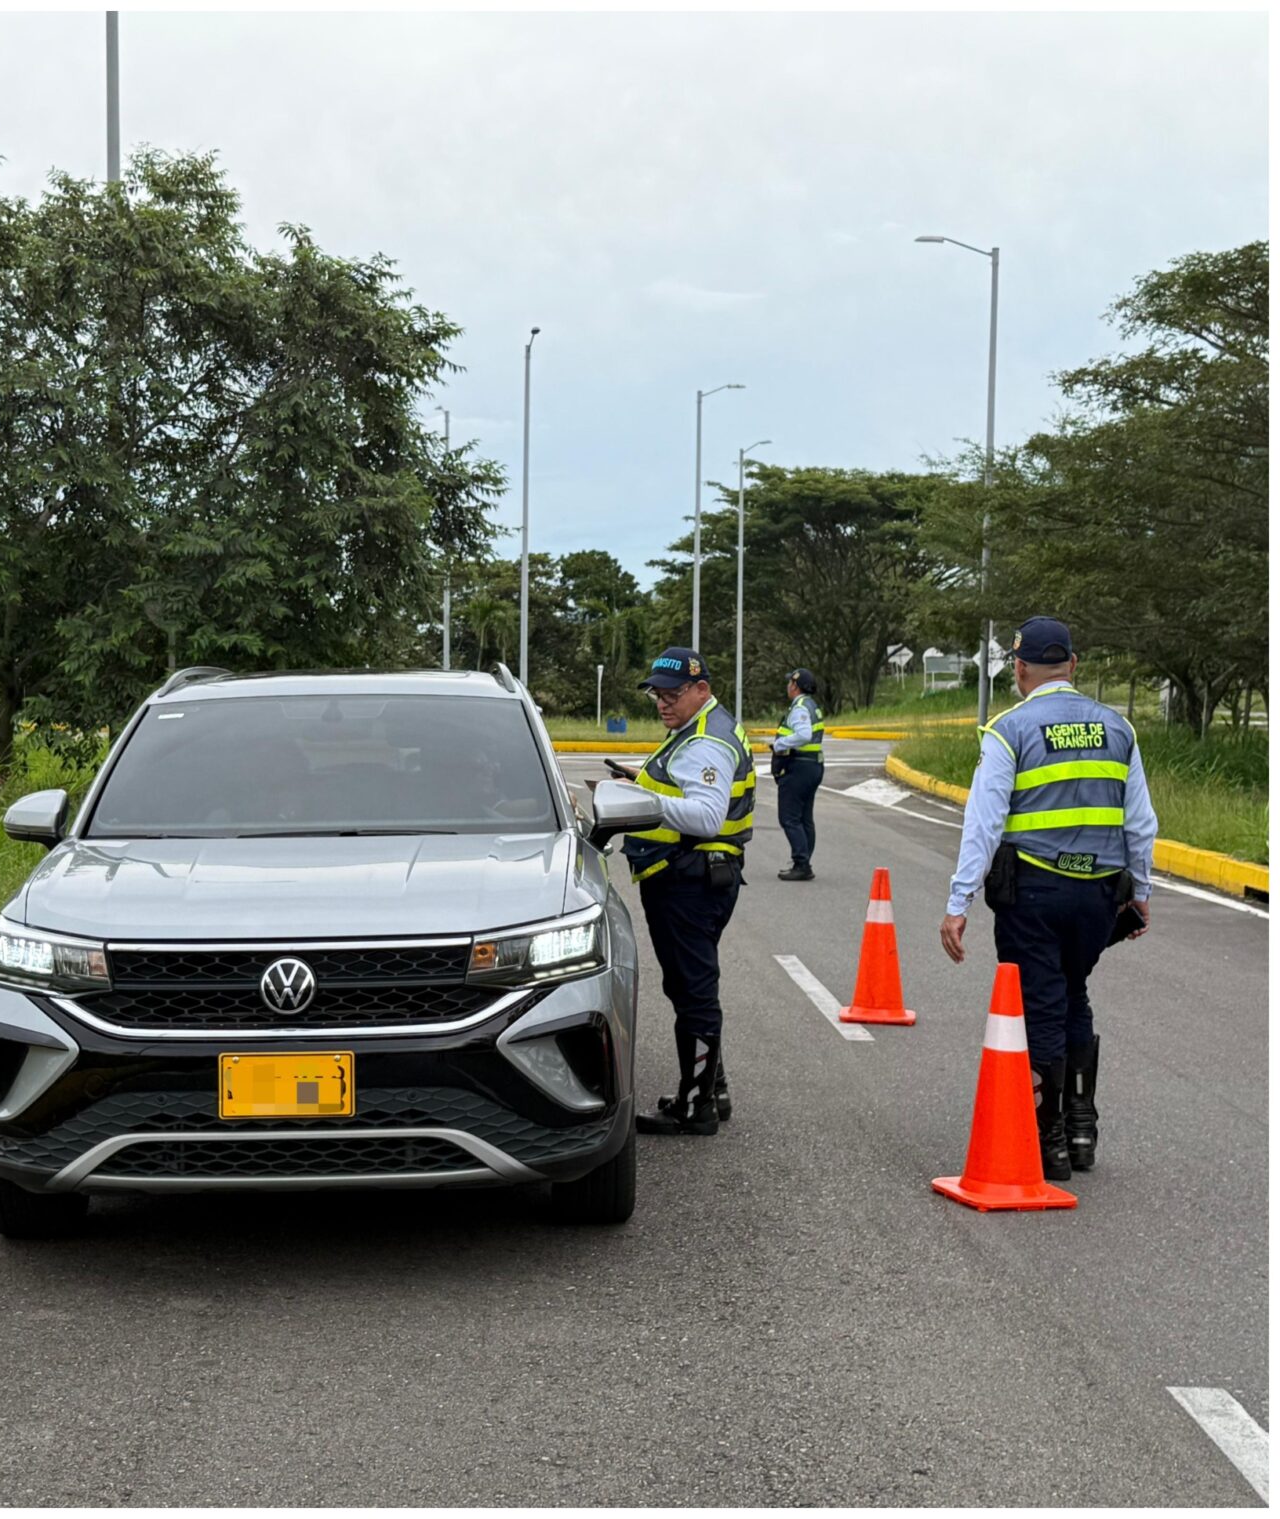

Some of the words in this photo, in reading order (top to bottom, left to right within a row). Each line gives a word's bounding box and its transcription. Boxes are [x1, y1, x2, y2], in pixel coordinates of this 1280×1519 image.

[1045, 724, 1088, 739] AGENTE
[1089, 723, 1104, 735] DE
[1058, 853, 1094, 872] 022
